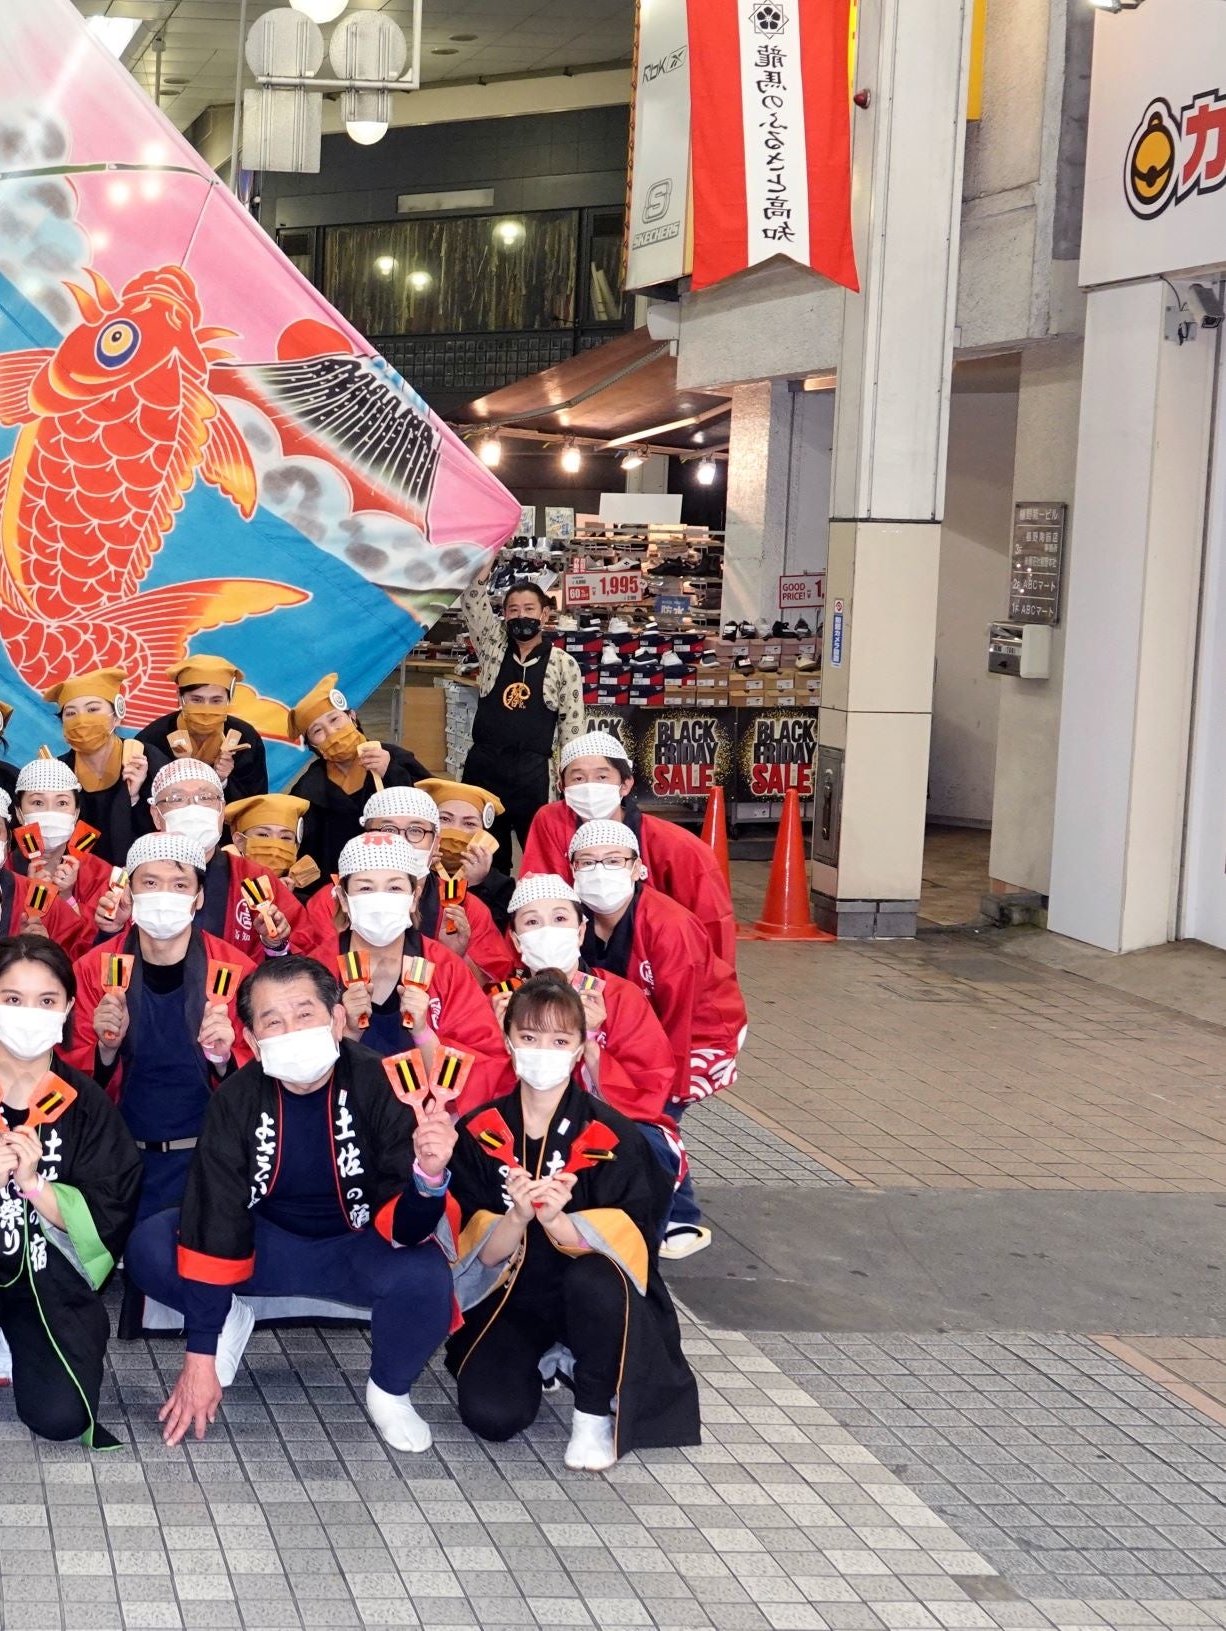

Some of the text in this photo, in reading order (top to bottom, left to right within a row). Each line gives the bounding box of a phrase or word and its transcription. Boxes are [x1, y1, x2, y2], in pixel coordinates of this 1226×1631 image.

[632, 220, 680, 250] SKECHERS
[599, 575, 640, 596] 1,995
[782, 582, 806, 591] GOOD
[782, 591, 806, 601] PRICE!
[657, 719, 717, 743] BLACK
[757, 719, 815, 743] BLACK
[654, 741, 719, 765] FRIDAY
[753, 741, 819, 765] FRIDAY
[653, 763, 714, 796] SALE
[751, 763, 812, 795] SALE
